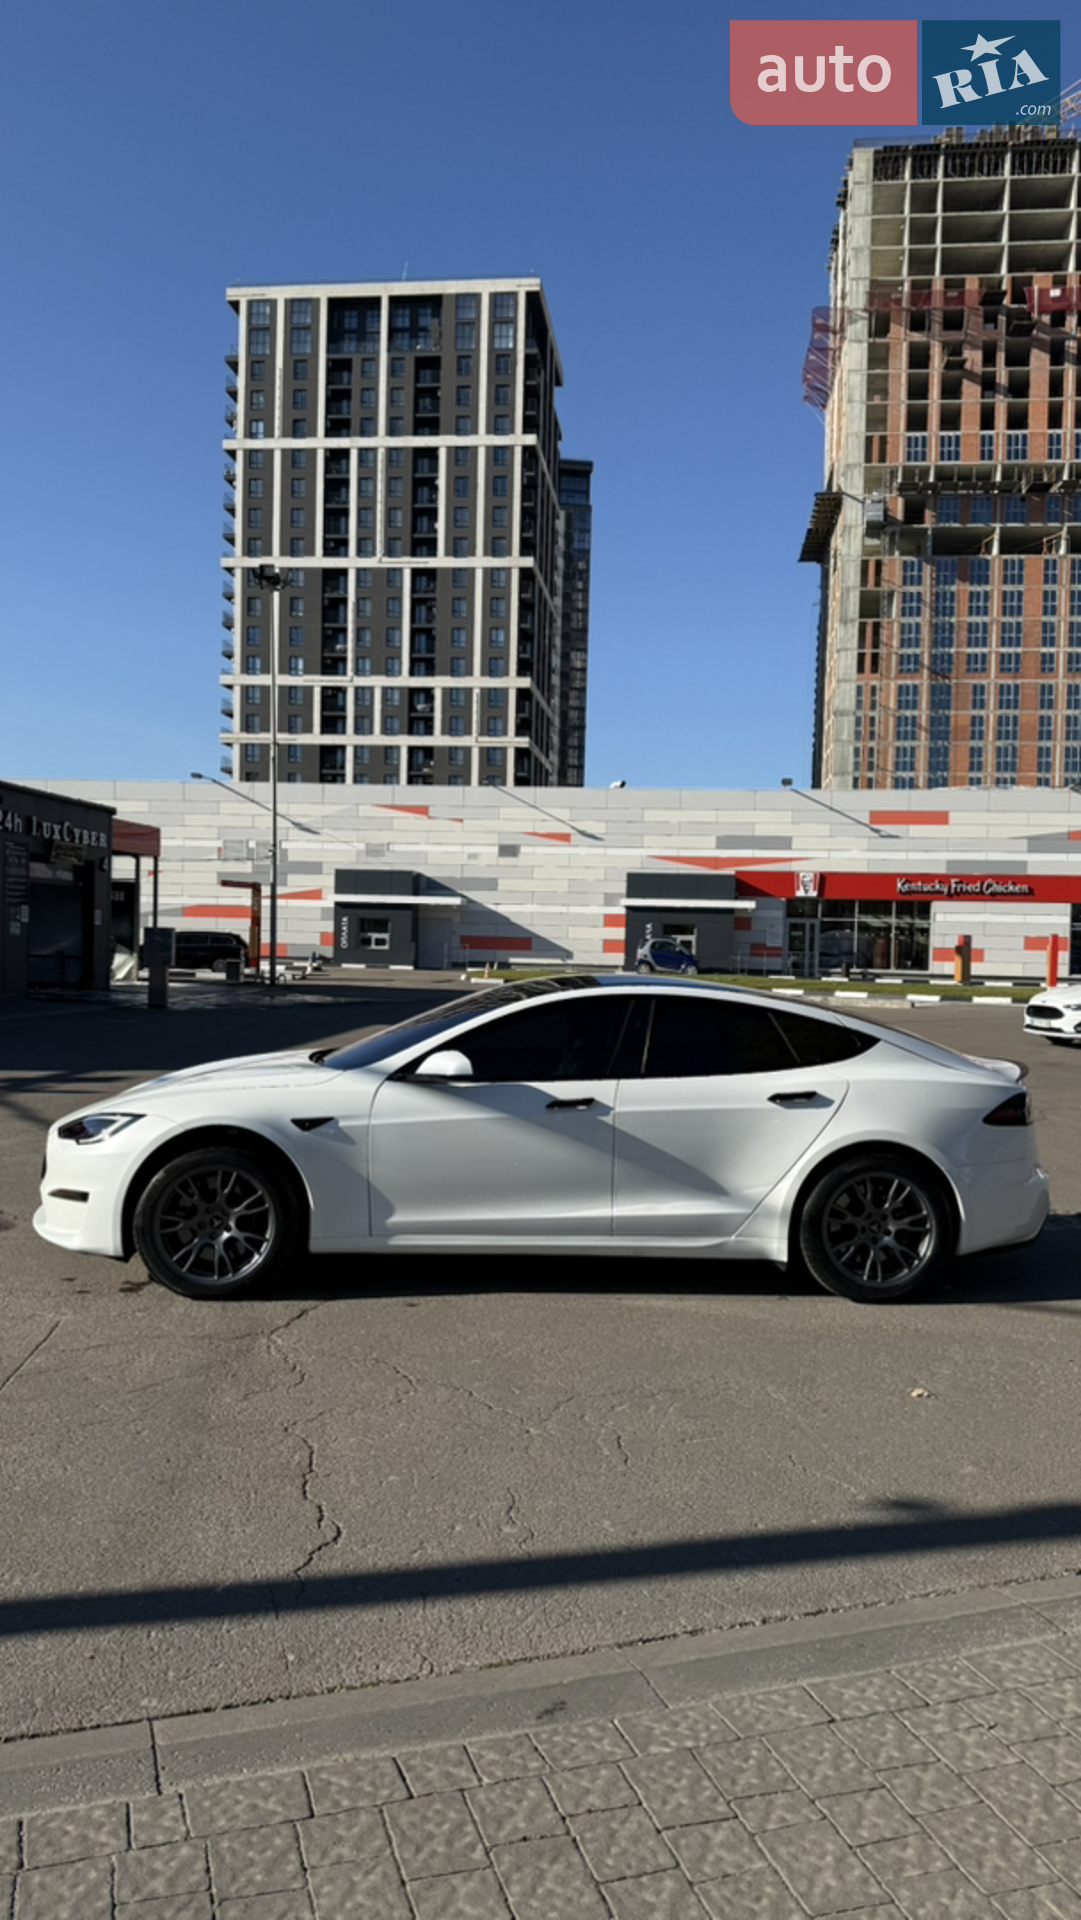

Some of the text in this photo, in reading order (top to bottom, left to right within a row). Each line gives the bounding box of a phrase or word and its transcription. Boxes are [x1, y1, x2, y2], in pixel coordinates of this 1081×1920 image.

[896, 877, 1029, 895] Kentucky Fried Chicken
